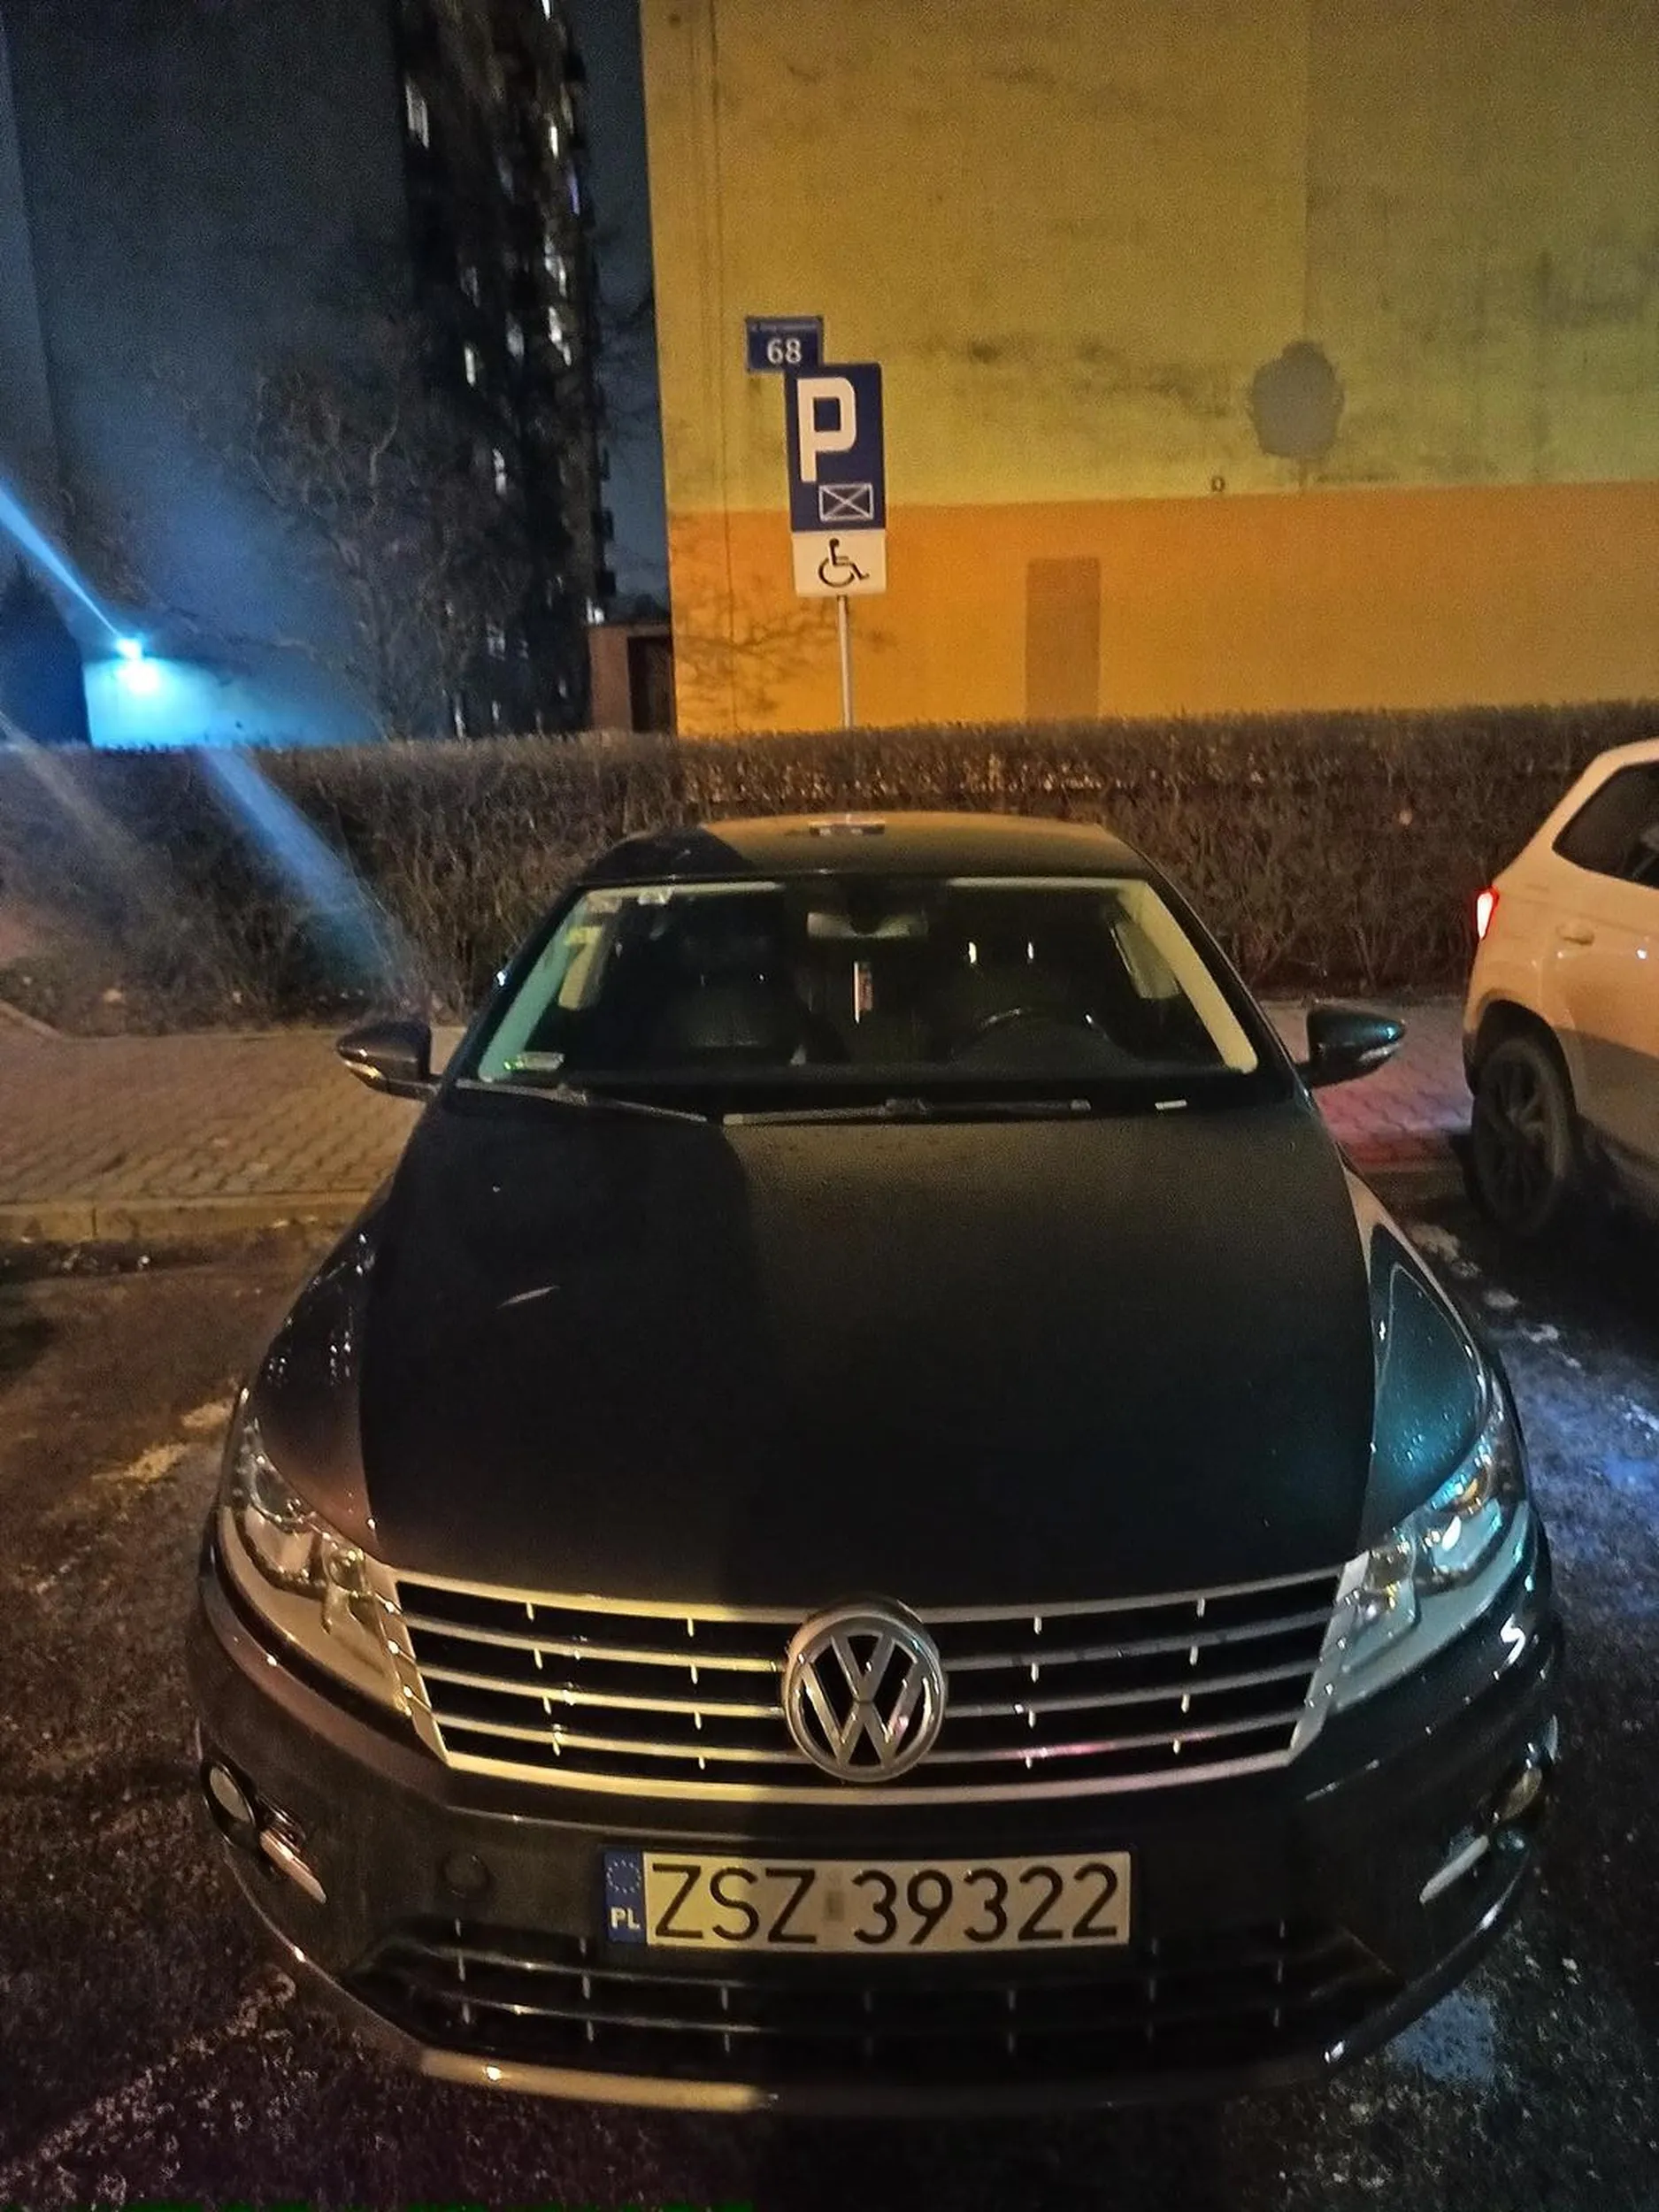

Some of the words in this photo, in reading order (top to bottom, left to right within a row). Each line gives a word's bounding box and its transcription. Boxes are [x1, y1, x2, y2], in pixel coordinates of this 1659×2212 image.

[767, 338, 802, 365] 68
[797, 377, 856, 482] P
[791, 1628, 927, 1773] VW
[610, 1907, 641, 1931] PL
[652, 1862, 817, 1945] ZSZ
[851, 1862, 1118, 1945] 39322
